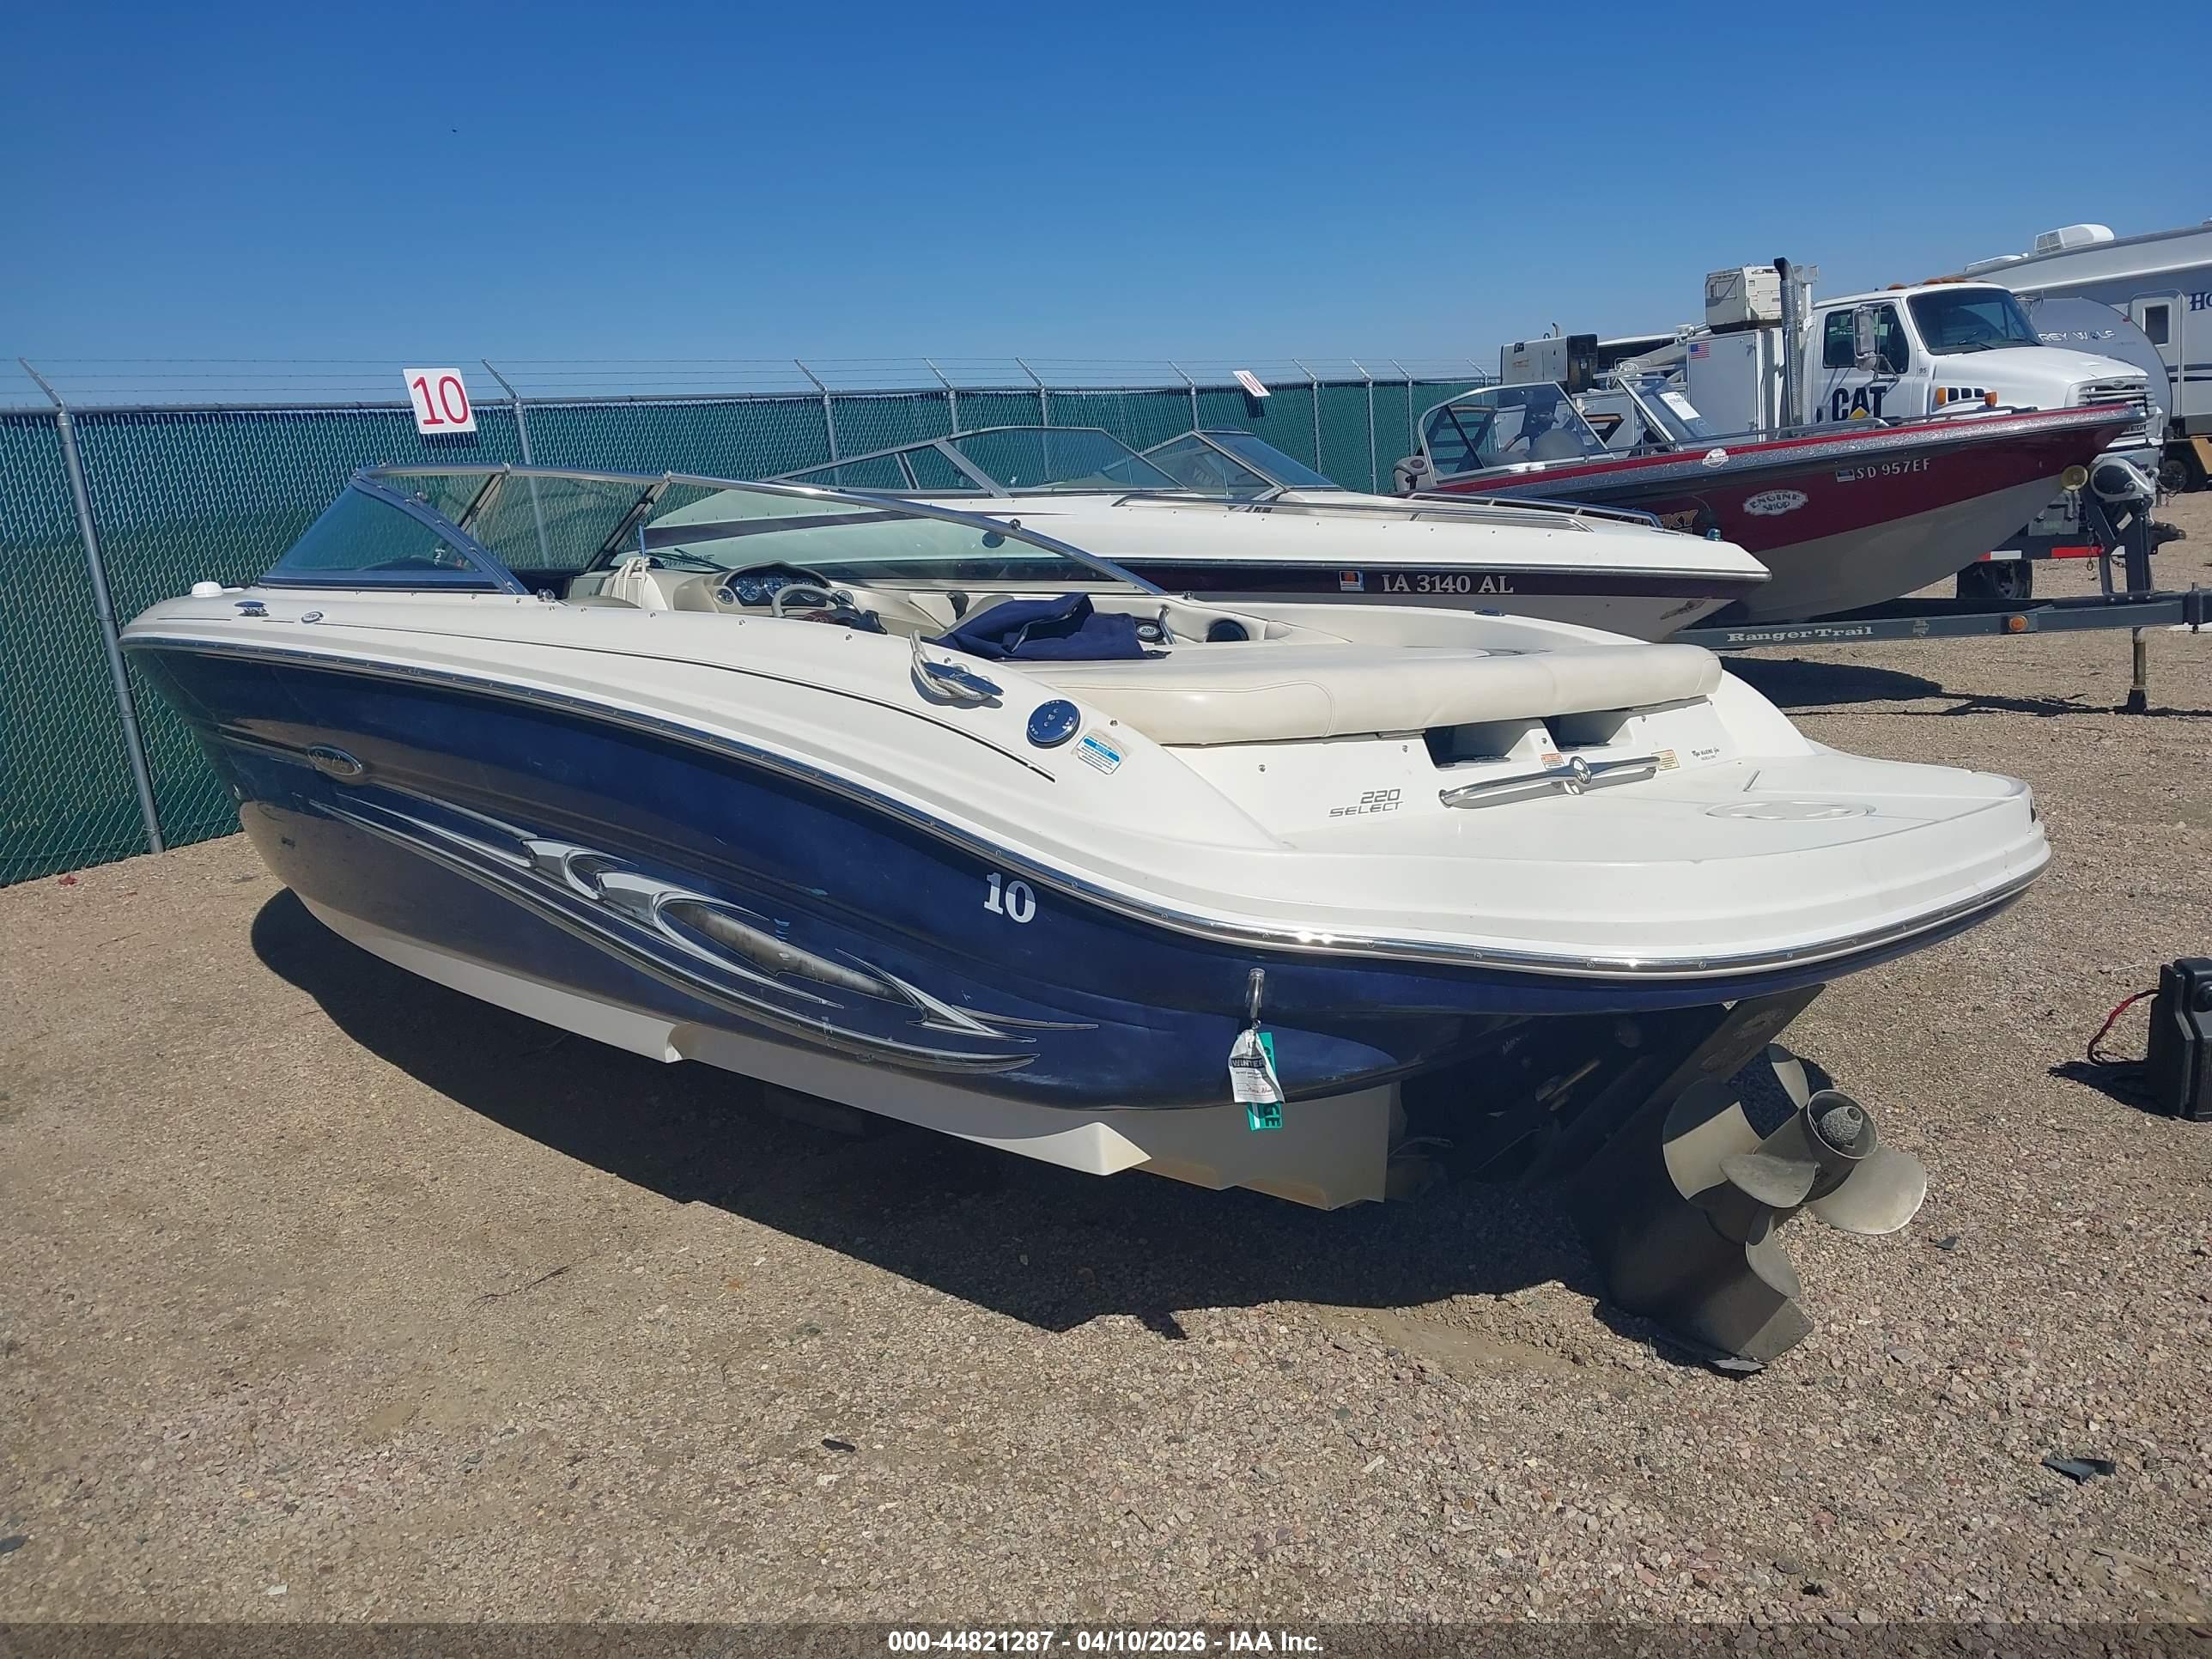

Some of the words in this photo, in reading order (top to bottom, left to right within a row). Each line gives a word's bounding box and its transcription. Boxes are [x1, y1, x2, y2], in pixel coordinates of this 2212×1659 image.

[413, 376, 468, 424] 10
[1832, 386, 1887, 421] CAT
[1856, 466, 1877, 479] SD
[1881, 458, 1931, 476] 957EF
[1749, 494, 1801, 508] ENGINE
[1382, 574, 1411, 592] IA
[1417, 574, 1471, 593] 3140
[1478, 575, 1514, 593] AL
[1360, 788, 1401, 805] 220
[1328, 801, 1404, 817] SELECT
[984, 872, 1036, 923] 10
